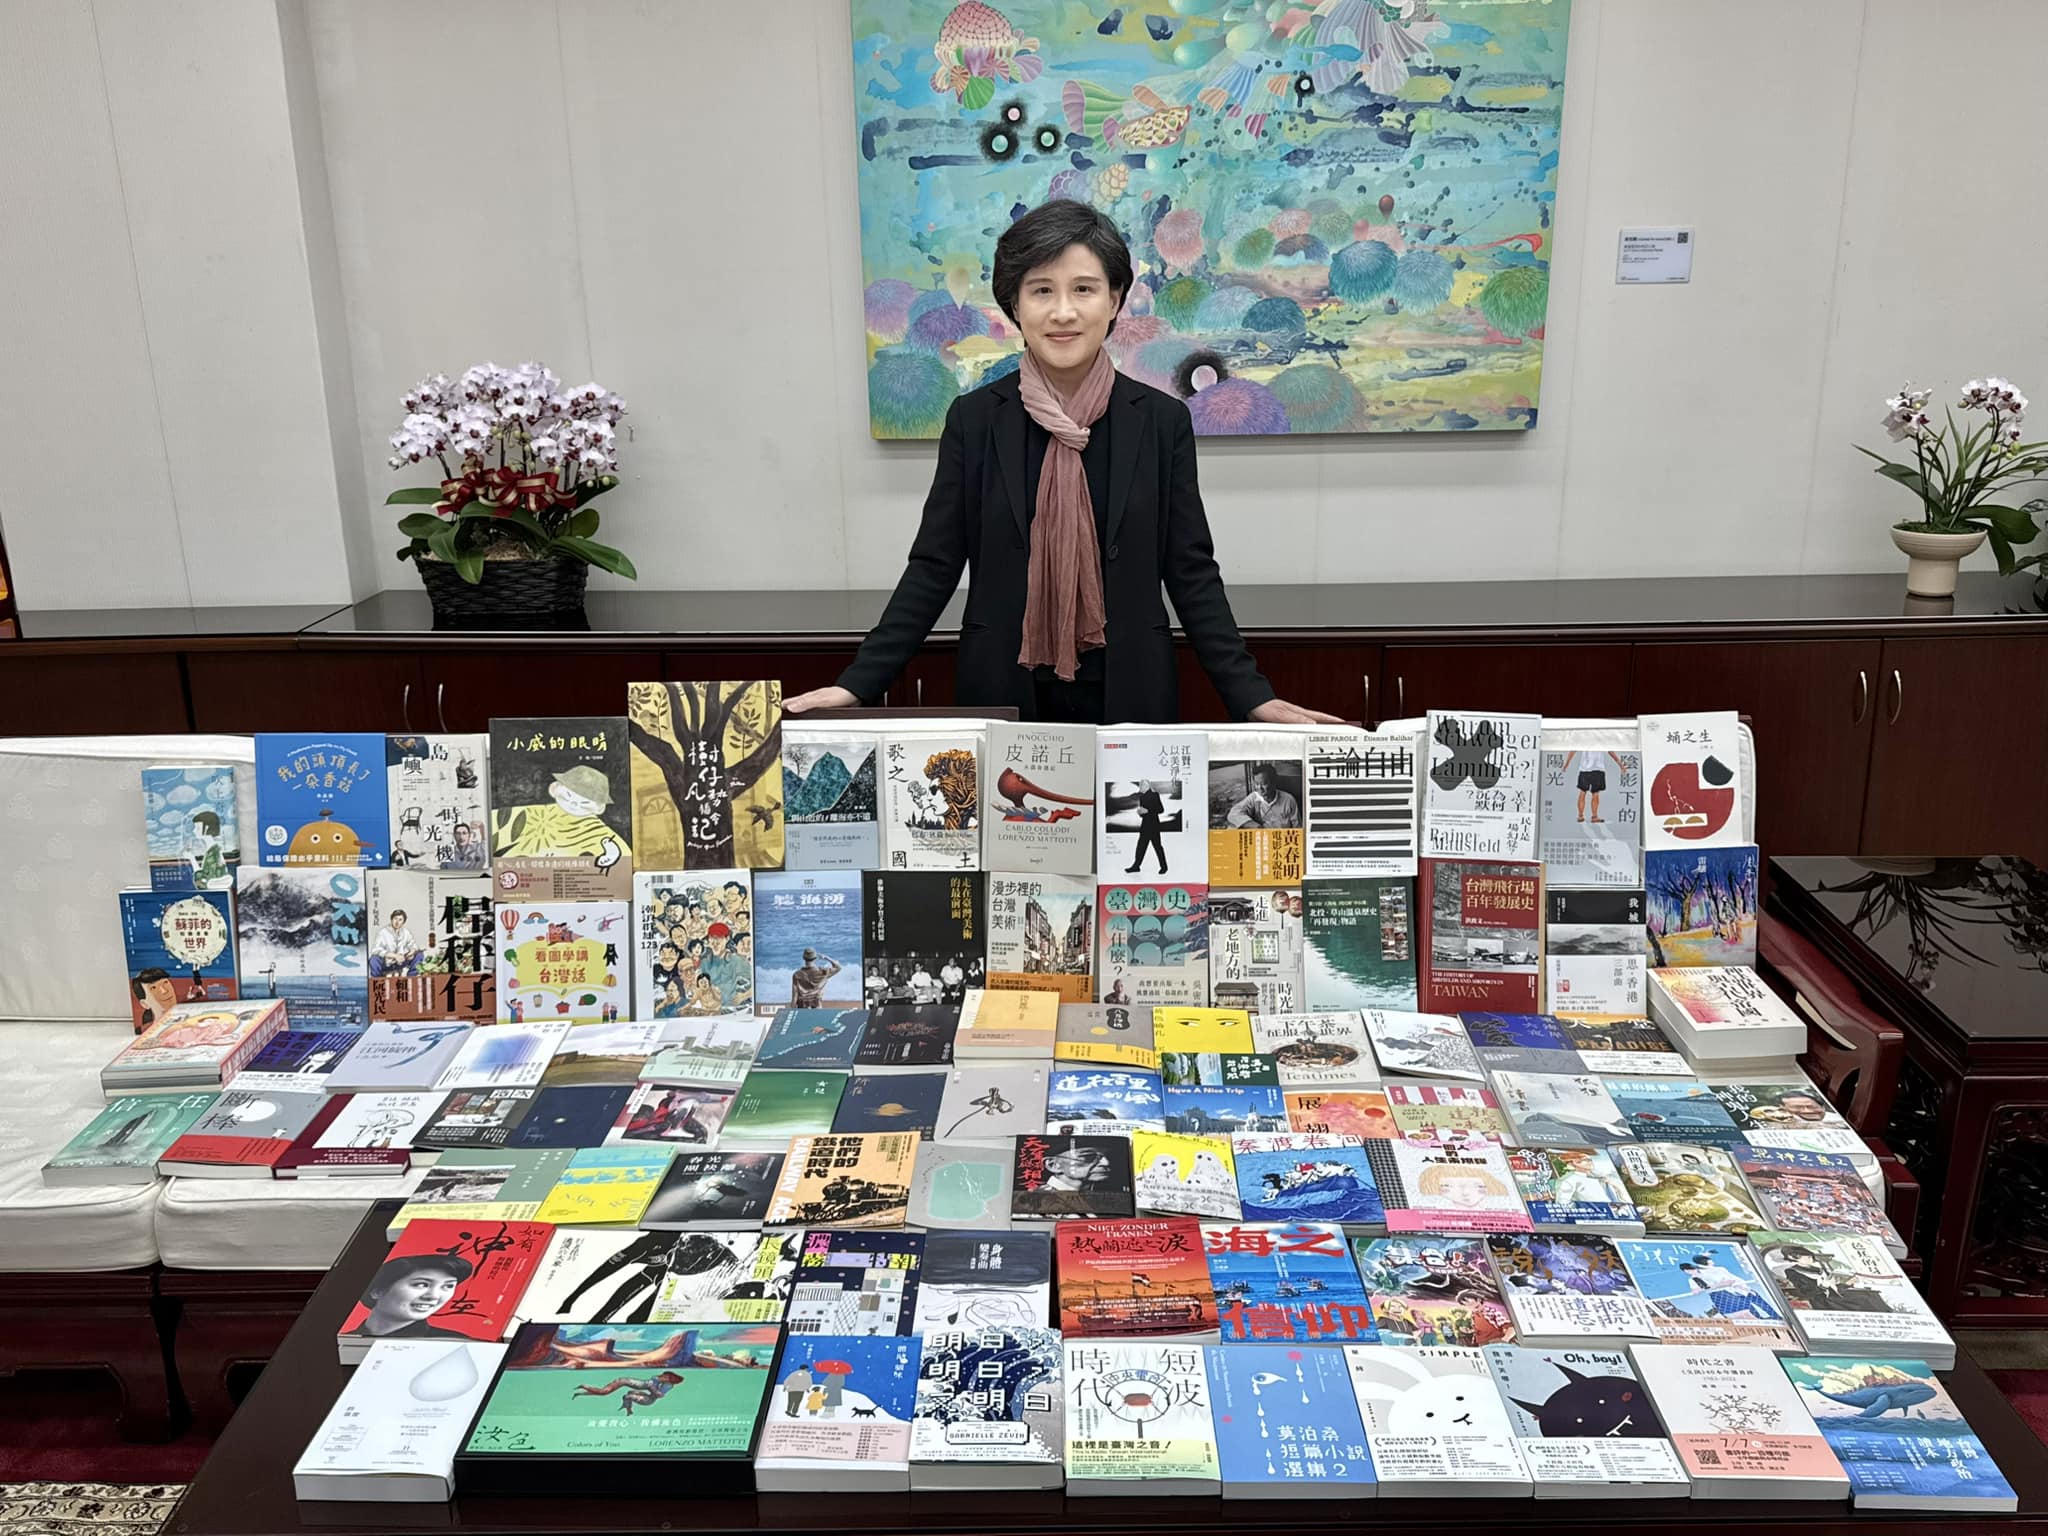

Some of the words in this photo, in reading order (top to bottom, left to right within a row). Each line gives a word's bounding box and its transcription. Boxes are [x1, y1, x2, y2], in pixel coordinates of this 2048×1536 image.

[507, 733, 608, 752] 小威的眼睛
[1017, 733, 1065, 743] PINOCCHIO
[1330, 735, 1358, 743] PAROLE
[1666, 729, 1713, 744] 蛹之生
[1005, 743, 1076, 765] 皮諾丘
[1181, 745, 1192, 776] 江賢二
[1309, 746, 1414, 779] 言論自由
[277, 754, 371, 782] 我的頭頂長了
[1546, 753, 1564, 787] 陽光
[1618, 754, 1638, 824] 陰影下的
[1283, 830, 1300, 881] 黃春明
[991, 880, 1042, 897] 漫步裡的
[1465, 878, 1535, 895] 台灣飛行場
[992, 898, 1016, 913] 台灣
[1108, 889, 1187, 911] 臺灣史
[1466, 894, 1535, 911] 百年發展史
[175, 918, 212, 930] 蘇菲的
[992, 915, 1016, 931] 美術
[184, 937, 206, 949] 世界
[535, 950, 588, 963] 看圖學講
[1225, 927, 1241, 981] 老地方的
[540, 968, 586, 984] 台灣話
[1432, 984, 1489, 998] TAIWAN
[1286, 1071, 1357, 1081] Teatimes
[1205, 1226, 1345, 1258] 海之
[1221, 1301, 1370, 1339] 信仰
[930, 1332, 1006, 1351] 明日
[1419, 1350, 1482, 1359] SIMPLE
[1564, 1353, 1590, 1364] Oh,
[1594, 1353, 1622, 1365] boy!
[928, 1360, 1004, 1381] 明日
[1070, 1348, 1113, 1407] 時代
[1159, 1348, 1205, 1408] 短波
[1277, 1425, 1340, 1442] 莫泊桑
[1280, 1443, 1369, 1461] 短篇小說
